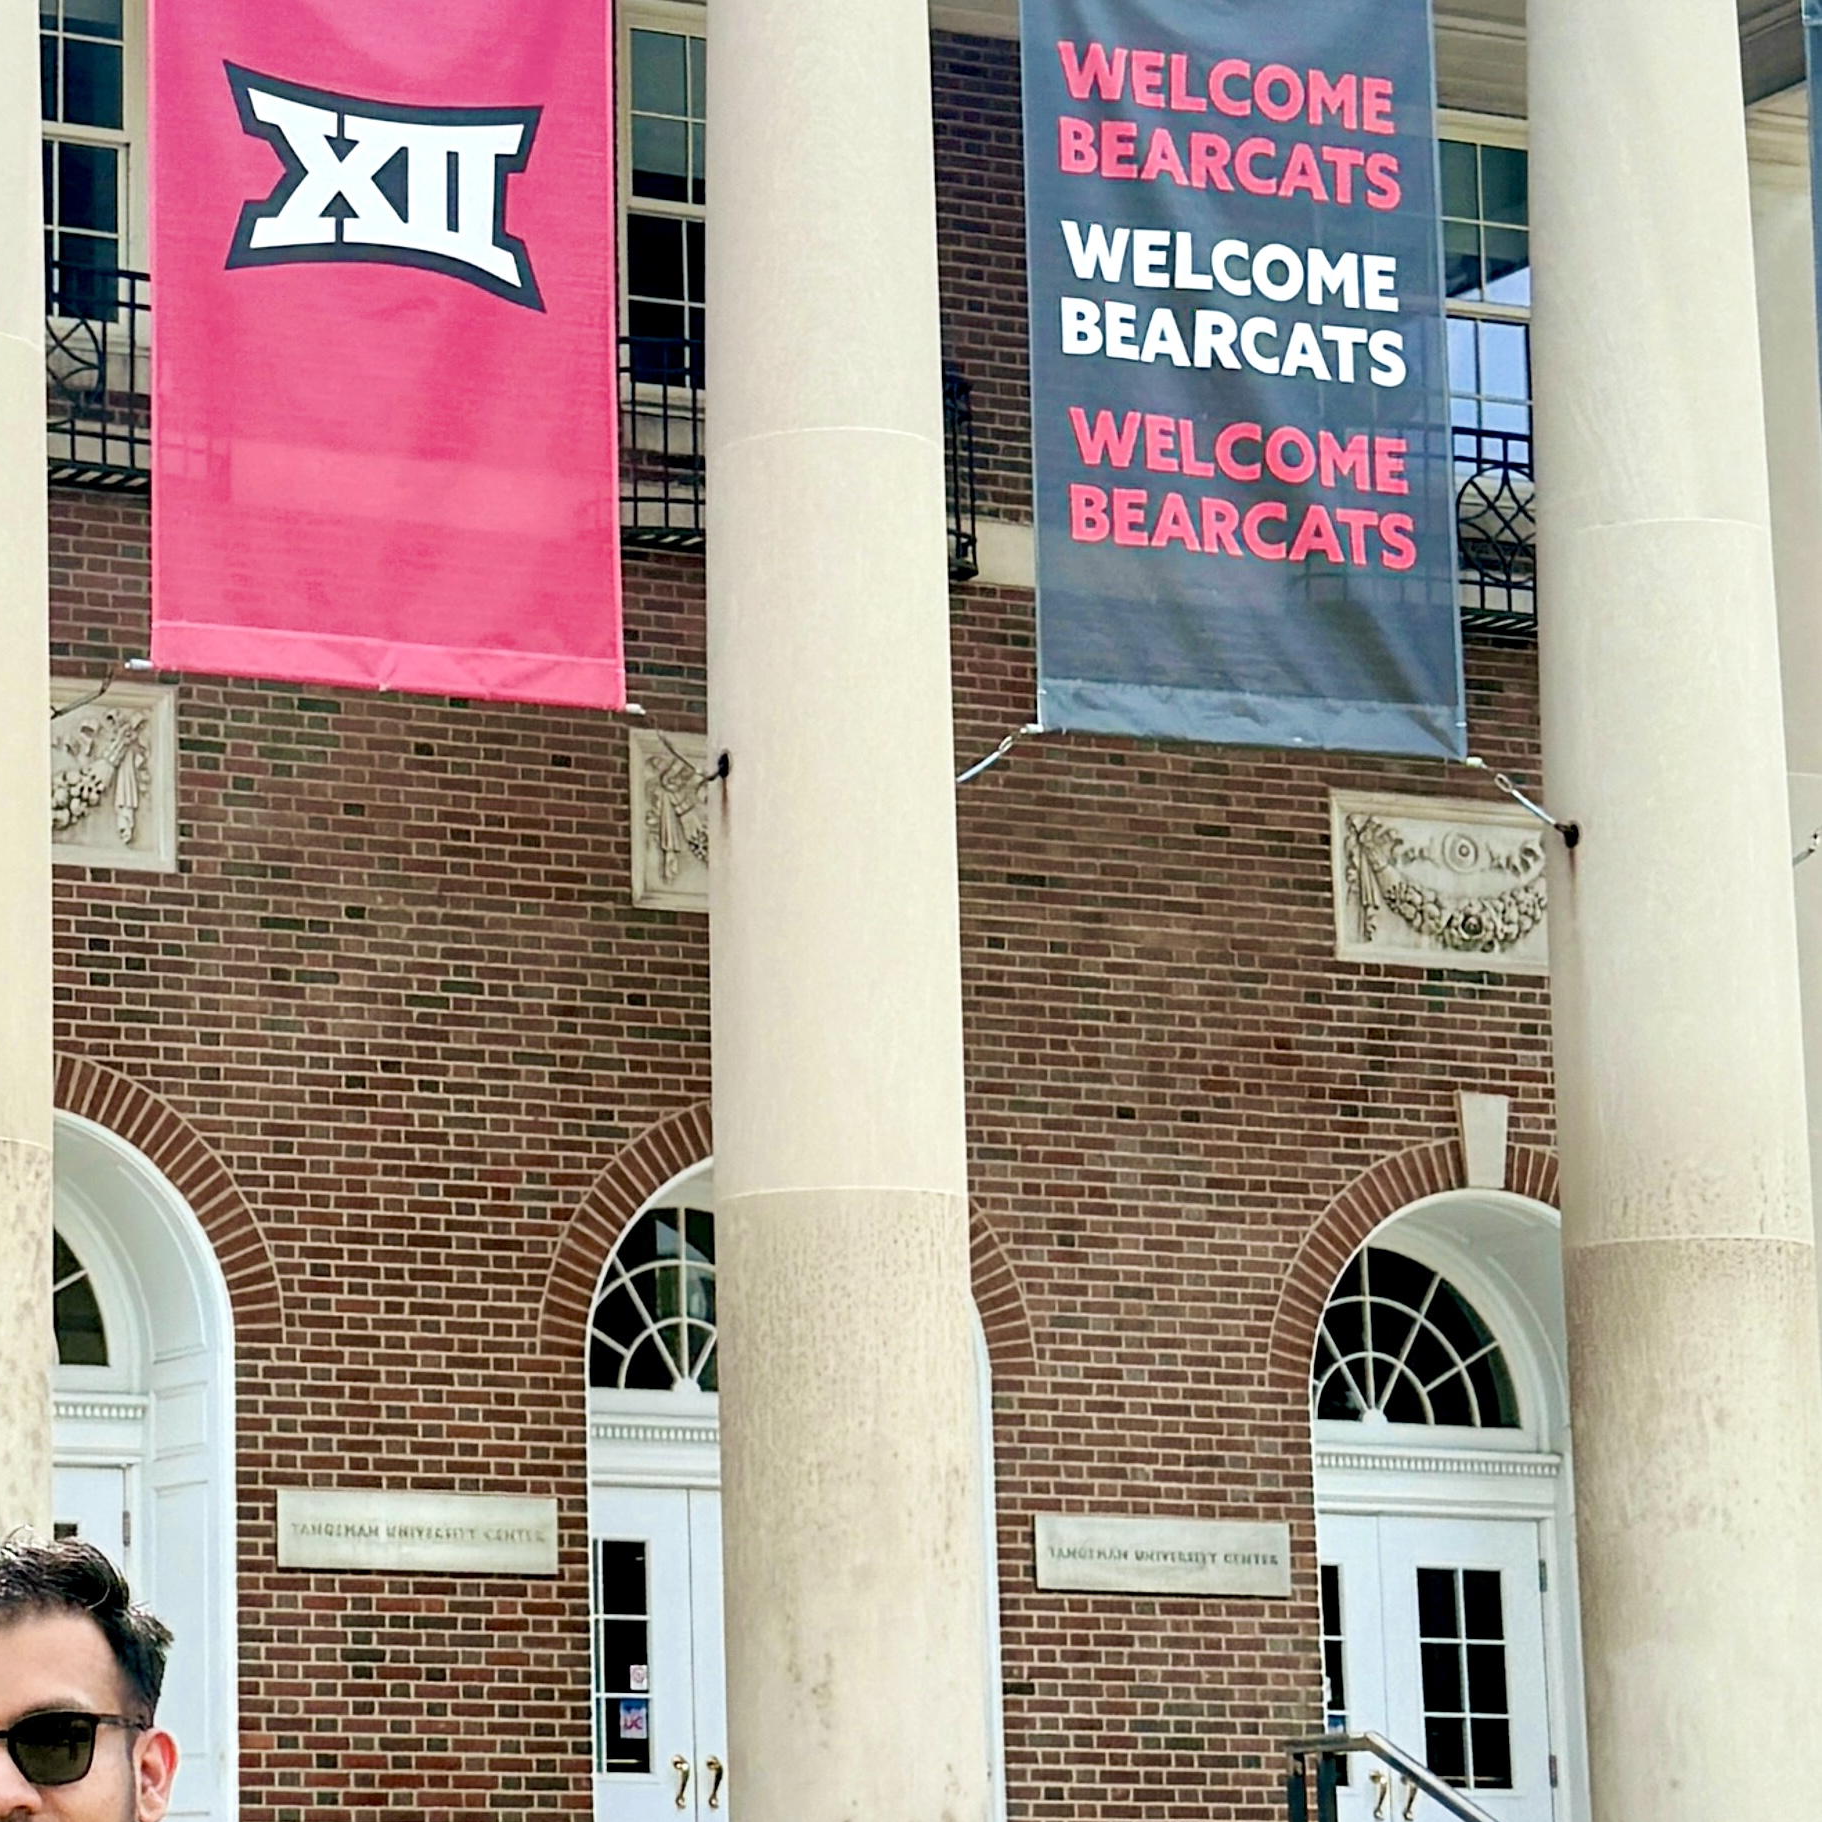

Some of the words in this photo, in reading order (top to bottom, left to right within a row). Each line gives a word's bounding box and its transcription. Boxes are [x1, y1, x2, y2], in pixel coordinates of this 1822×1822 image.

[1058, 41, 1395, 135] WELCOME
[238, 78, 533, 296] XII
[1058, 119, 1402, 211] BEARCATS
[1060, 220, 1399, 313] WELCOME
[1060, 298, 1406, 387] BEARCATS
[1068, 407, 1410, 495] WELCOME
[1069, 483, 1418, 571] BEARCATS
[386, 1525, 477, 1541] UNIVERSITY
[482, 1527, 546, 1543] CENTER
[1134, 1549, 1218, 1565] UNIVERSITY
[1223, 1551, 1279, 1566] CENTER
